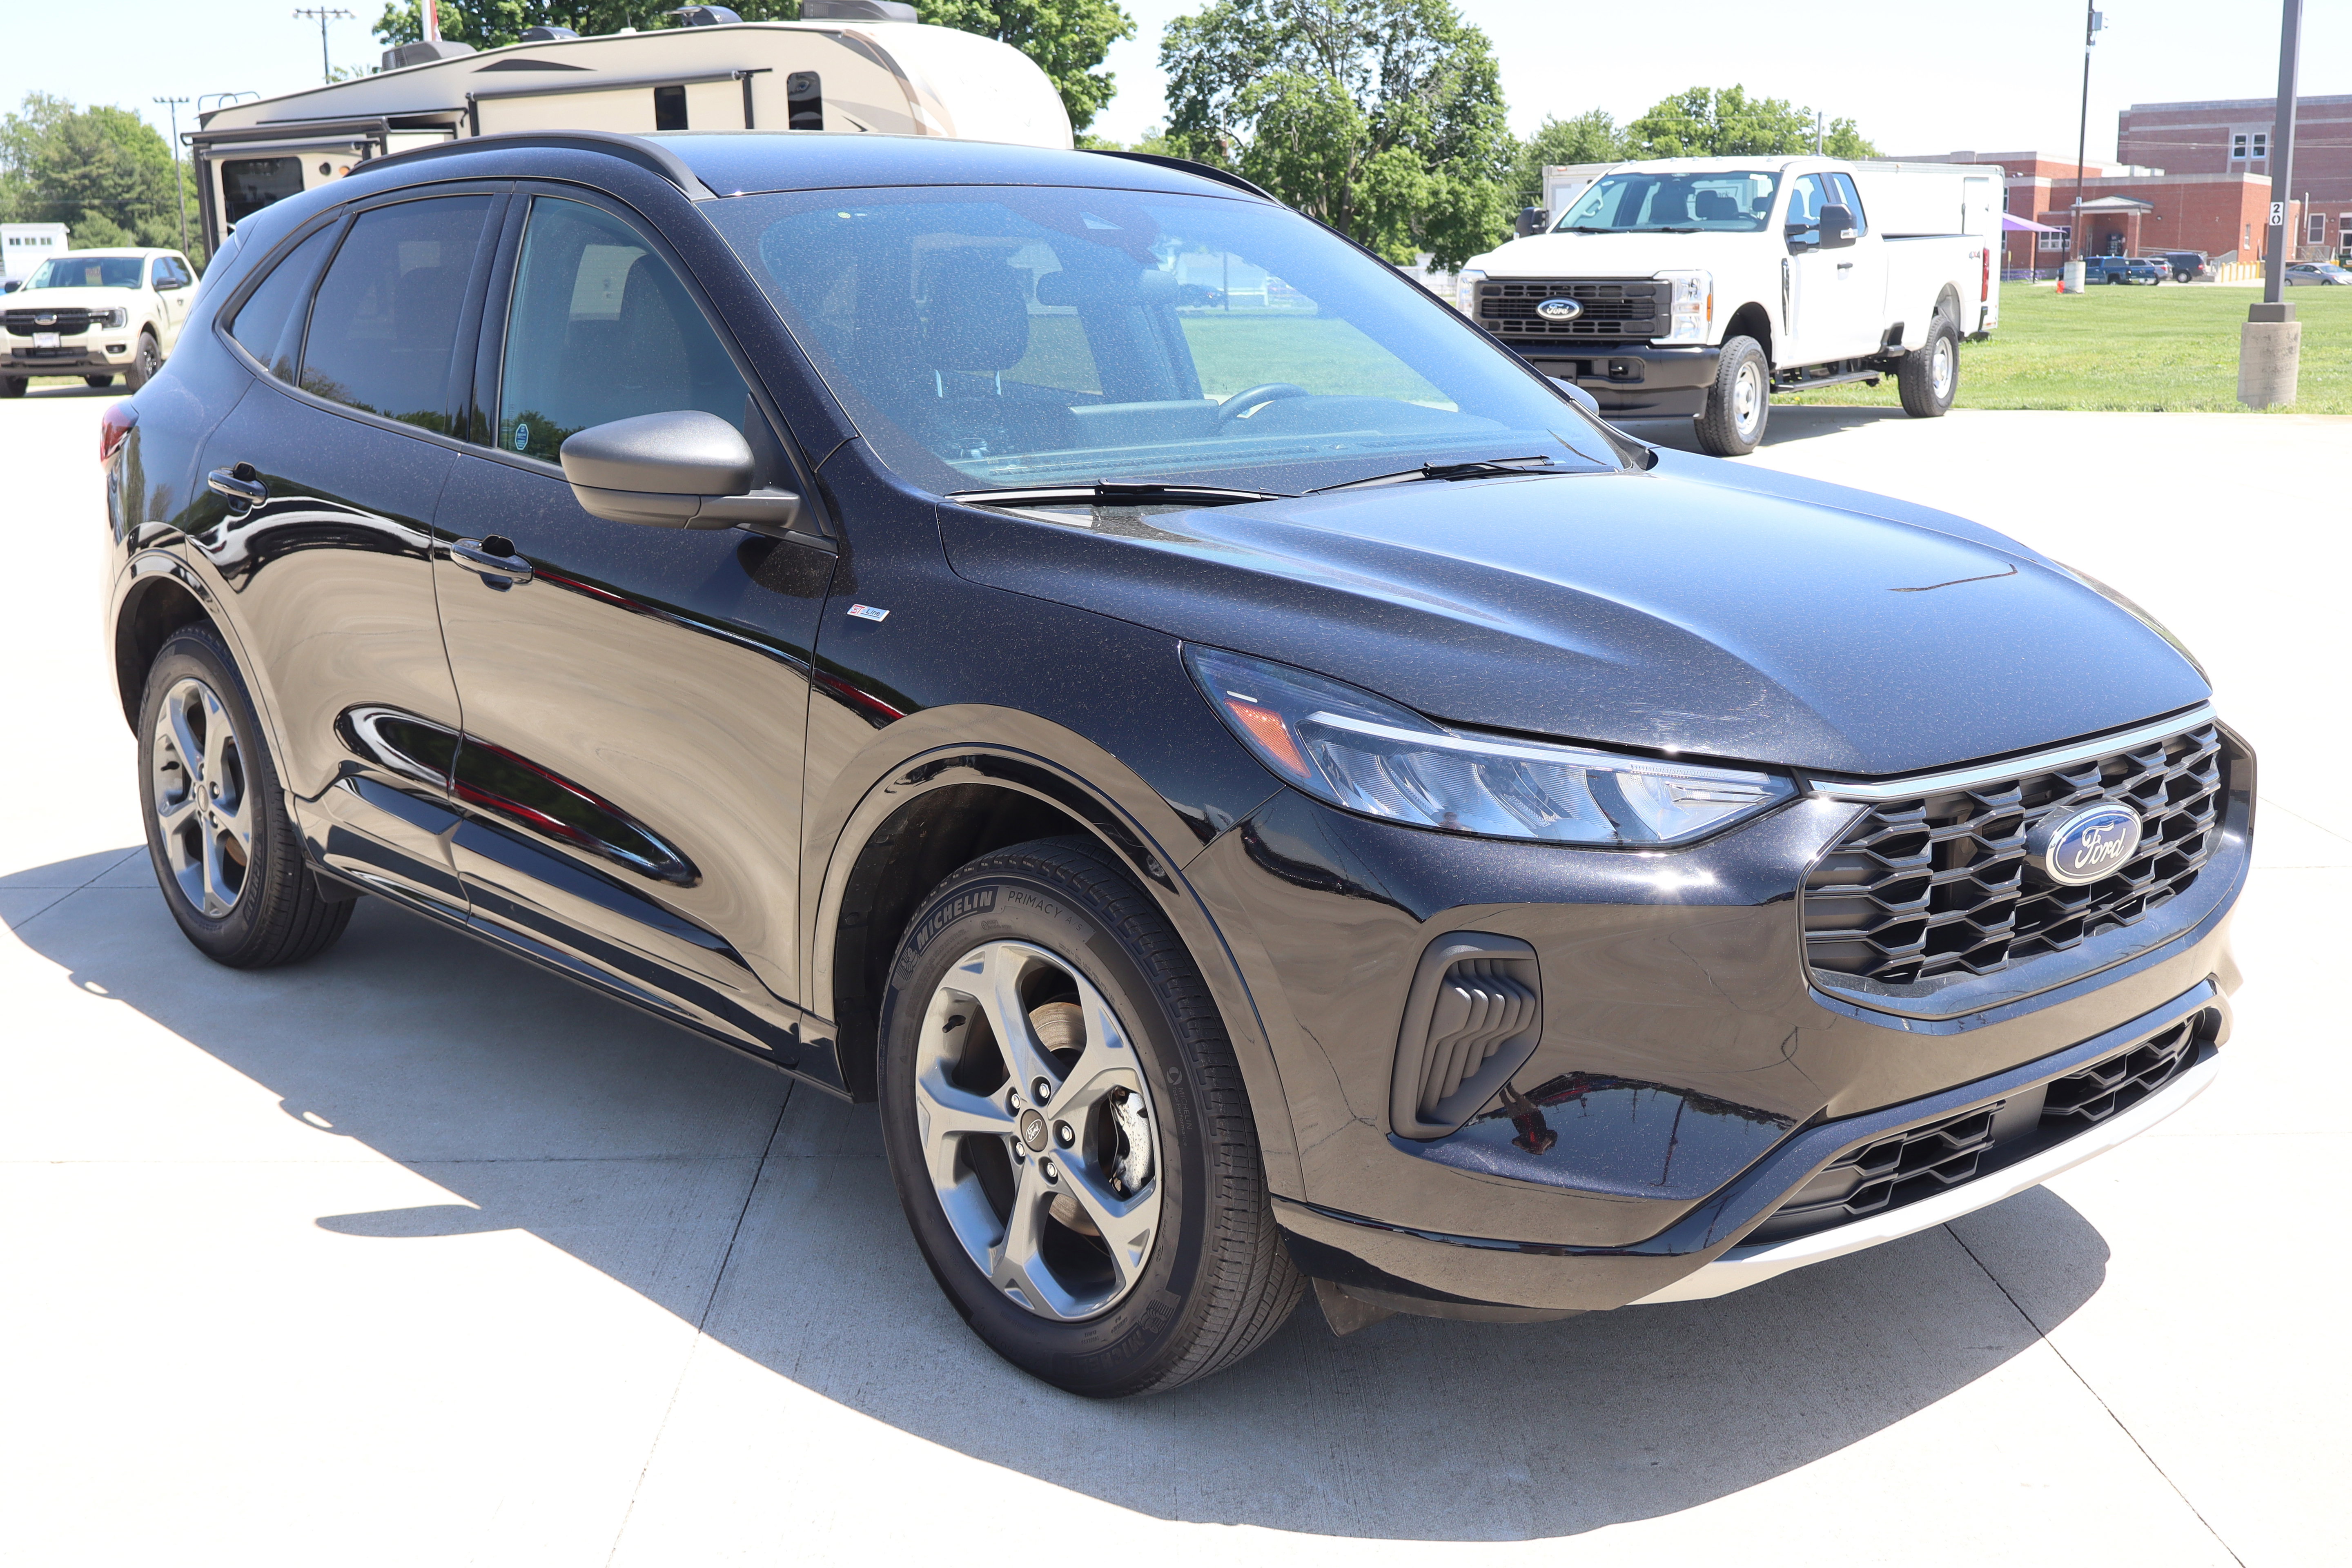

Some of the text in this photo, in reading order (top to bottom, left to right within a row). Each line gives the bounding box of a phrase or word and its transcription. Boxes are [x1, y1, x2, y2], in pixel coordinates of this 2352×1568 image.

[1546, 303, 1570, 314] Ford
[850, 605, 866, 615] ST
[2074, 822, 2127, 869] Ford
[916, 890, 993, 951] MICHELIN
[1007, 890, 1083, 931] PRIMACY A/S
[1176, 1103, 1187, 1147] Performance
[1178, 1087, 1193, 1130] MICHELIN
[1027, 1123, 1039, 1140] Ford
[1054, 1329, 1145, 1375] MICHELIN
